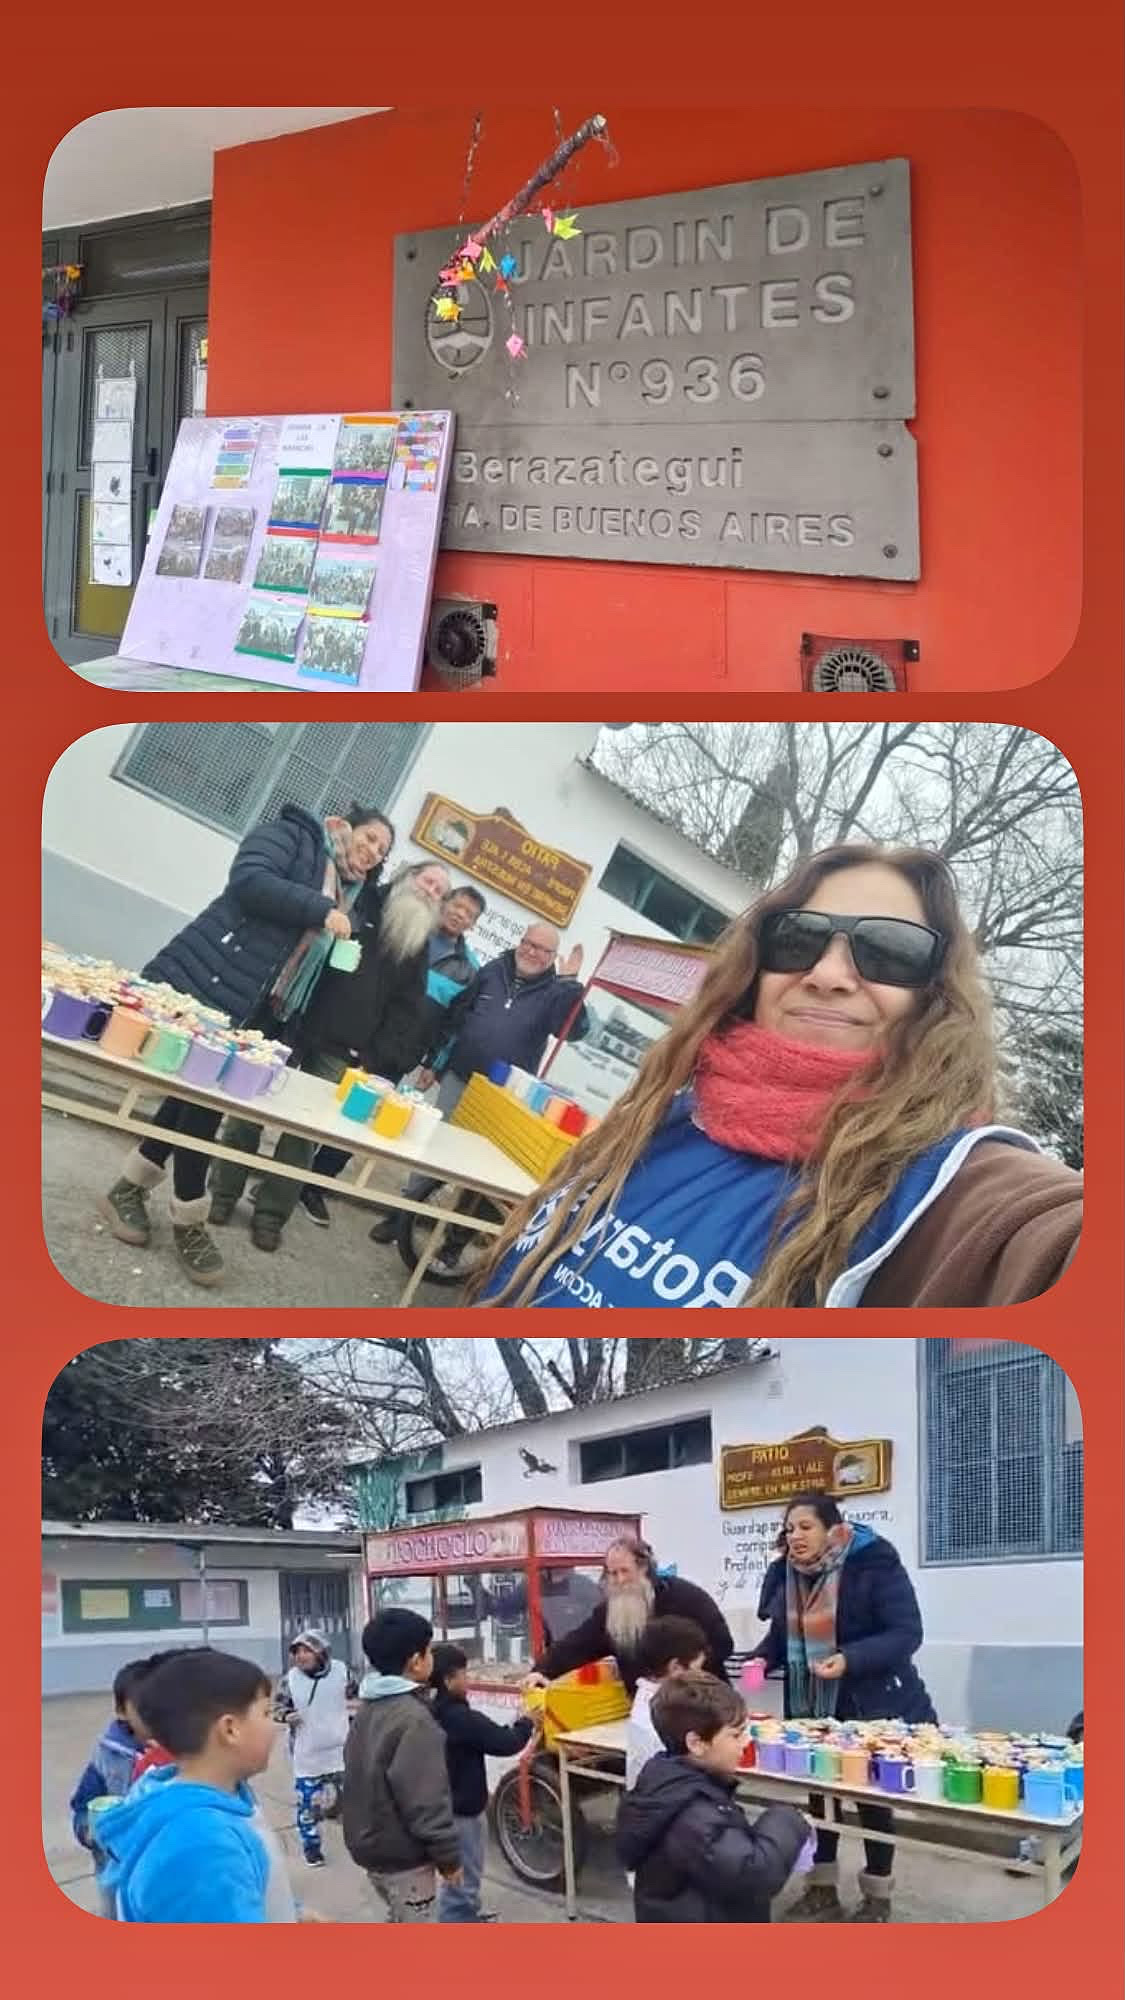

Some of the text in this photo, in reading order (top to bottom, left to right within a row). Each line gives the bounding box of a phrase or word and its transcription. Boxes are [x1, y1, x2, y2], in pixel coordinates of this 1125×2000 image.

[512, 196, 866, 284] JARDIN DE
[523, 272, 856, 346] INFANTES
[456, 447, 745, 495] Berazategui
[500, 504, 542, 532] DE
[553, 506, 701, 541] BUENOS
[718, 512, 857, 548] AIRES
[752, 1446, 790, 1464] PATIO
